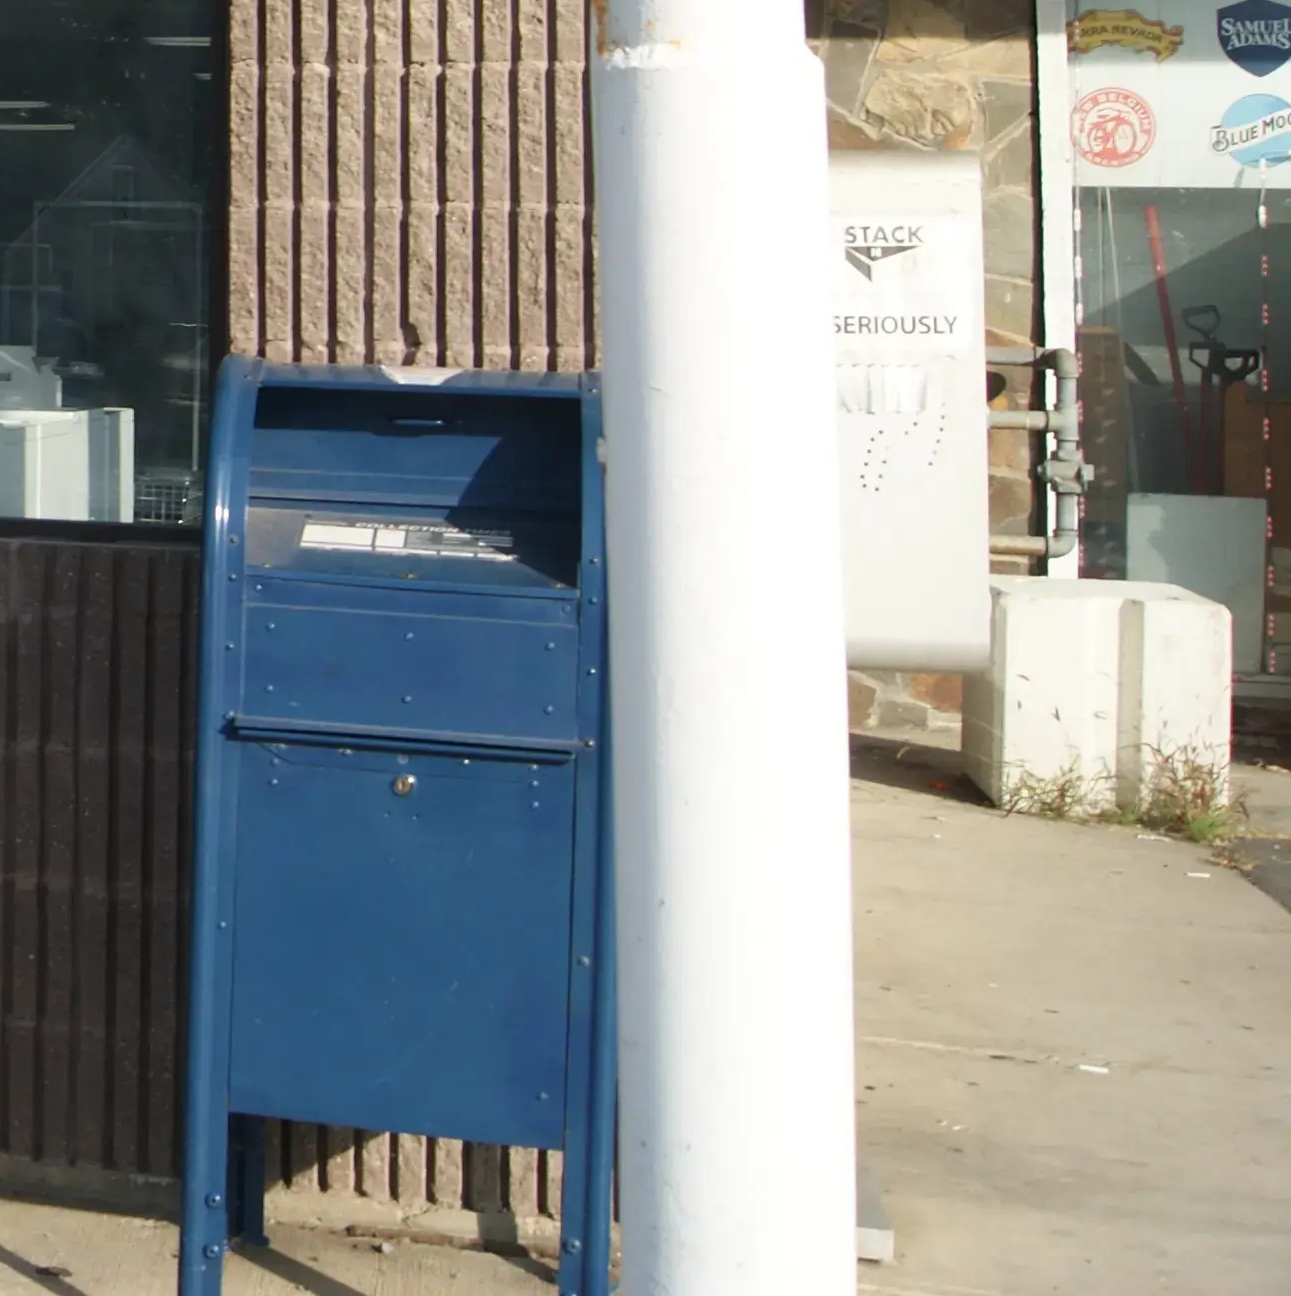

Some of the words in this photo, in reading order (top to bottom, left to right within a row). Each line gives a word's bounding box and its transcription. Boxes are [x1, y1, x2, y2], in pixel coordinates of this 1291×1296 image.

[1221, 17, 1291, 36] SAMUEL
[1227, 33, 1291, 50] ADAMS
[1212, 125, 1259, 152] BLUE
[845, 225, 924, 244] STACK
[355, 522, 460, 533] COLLECTION
